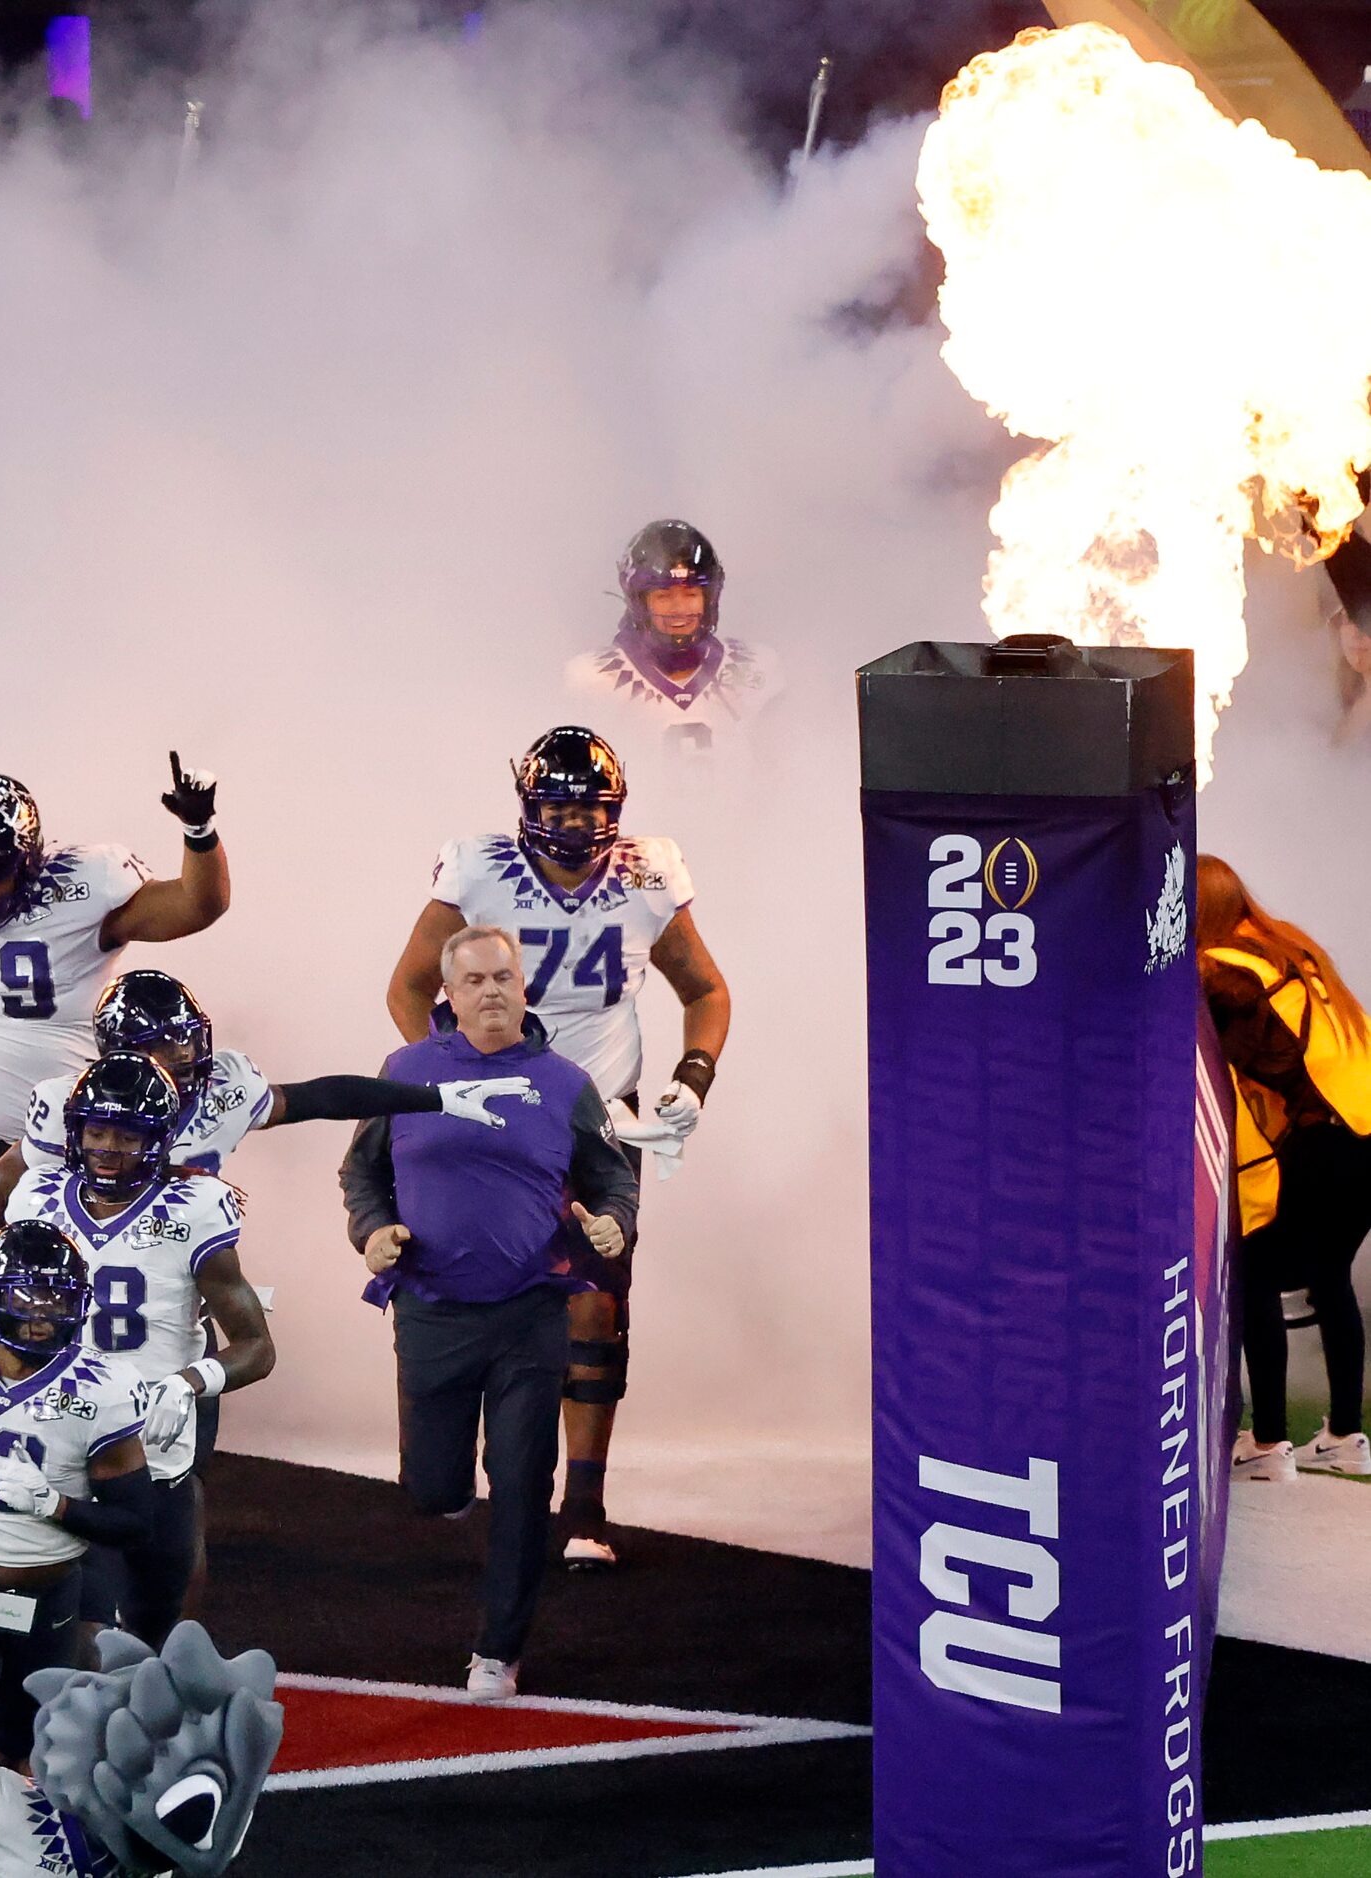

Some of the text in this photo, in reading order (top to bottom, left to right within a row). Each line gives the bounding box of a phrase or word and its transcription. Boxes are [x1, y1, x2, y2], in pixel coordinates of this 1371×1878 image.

[41, 883, 90, 904] 2023
[620, 872, 667, 890] 2023
[928, 911, 1038, 987] 23
[519, 926, 628, 1008] 74
[204, 1085, 247, 1118] 2023
[138, 1215, 191, 1243] 2023
[44, 1387, 98, 1420] 2023
[130, 1380, 149, 1417] 13
[919, 1455, 1062, 1714] TCU
[1160, 1256, 1195, 1878] HORNED FROGS
